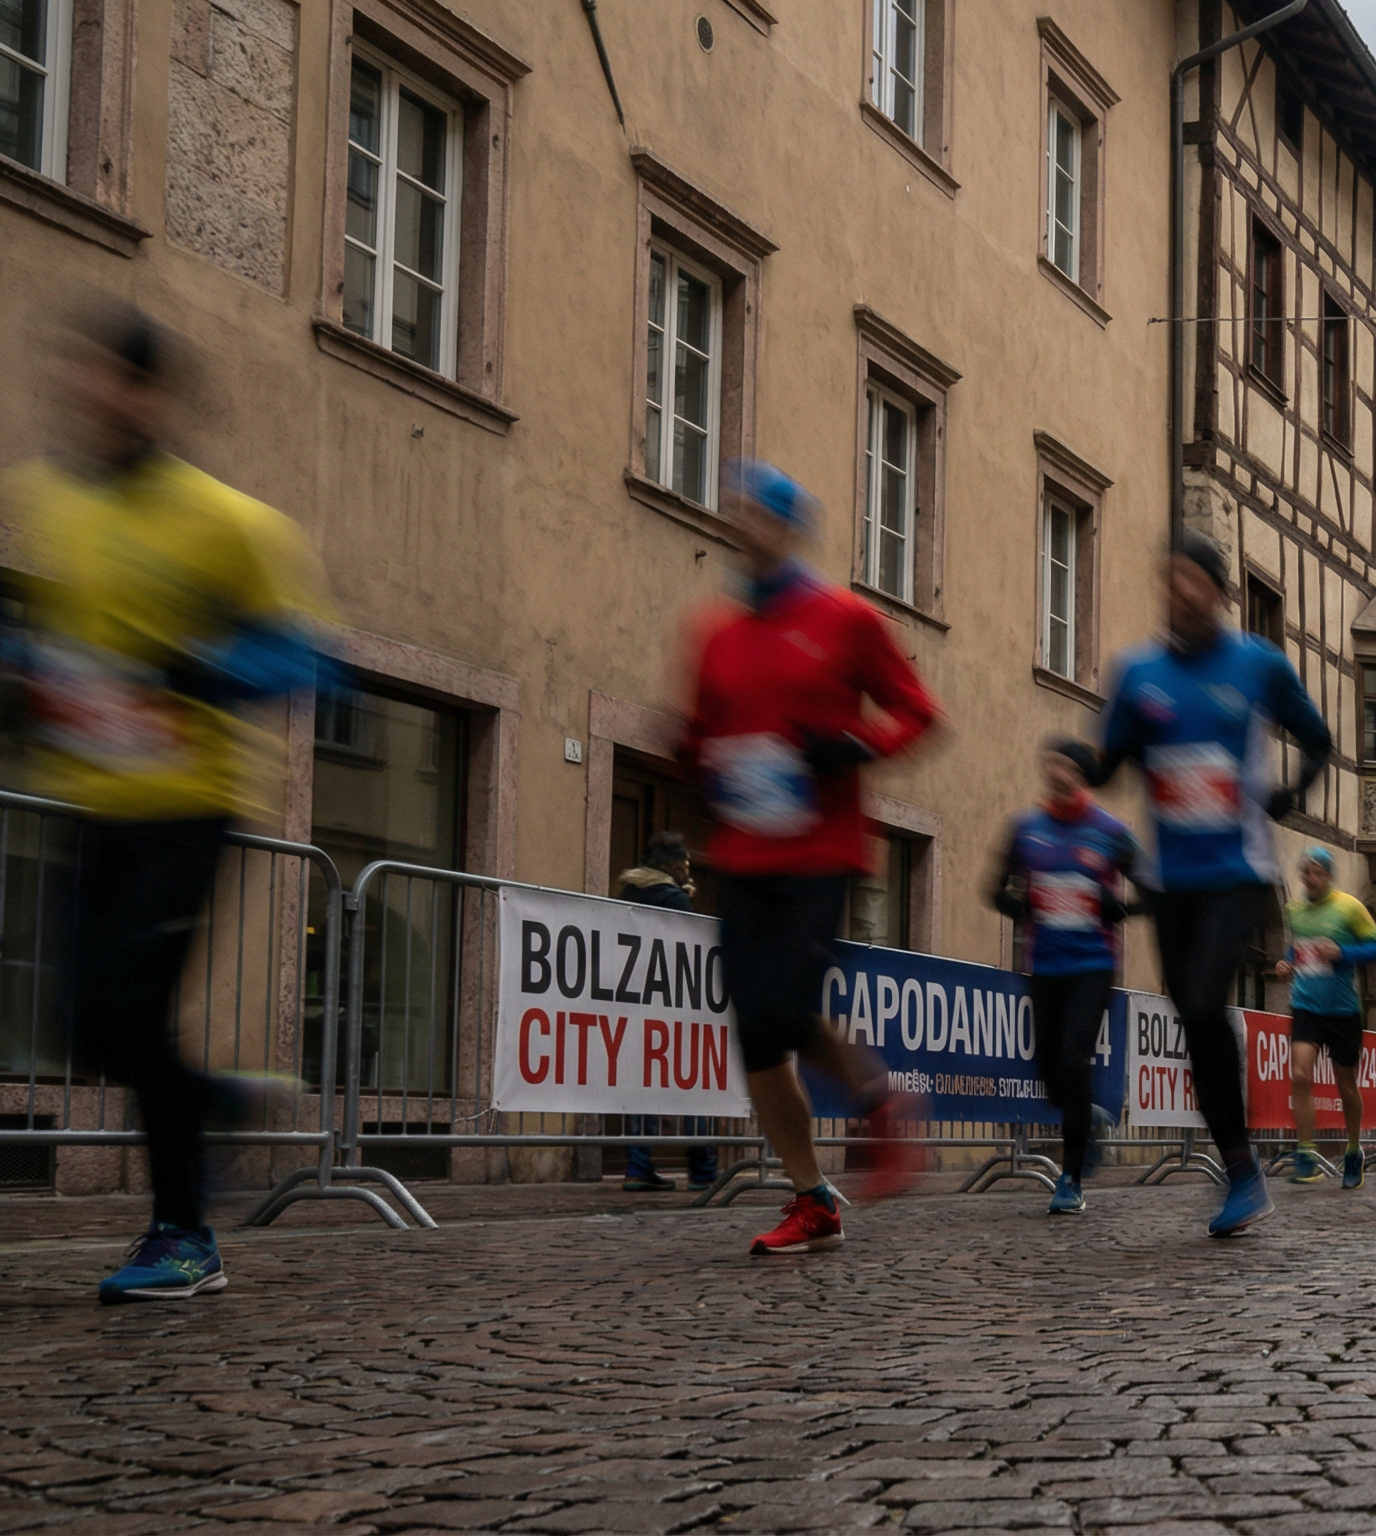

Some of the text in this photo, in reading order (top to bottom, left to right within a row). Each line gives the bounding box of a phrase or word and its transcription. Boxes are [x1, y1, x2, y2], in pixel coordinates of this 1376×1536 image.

[521, 920, 730, 1013] BOLZANO
[519, 1008, 728, 1091] CITY RUN
[821, 966, 1036, 1060] CAPODANNO
[1138, 1012, 1191, 1061] BOLZ
[1139, 1064, 1178, 1111] CITY
